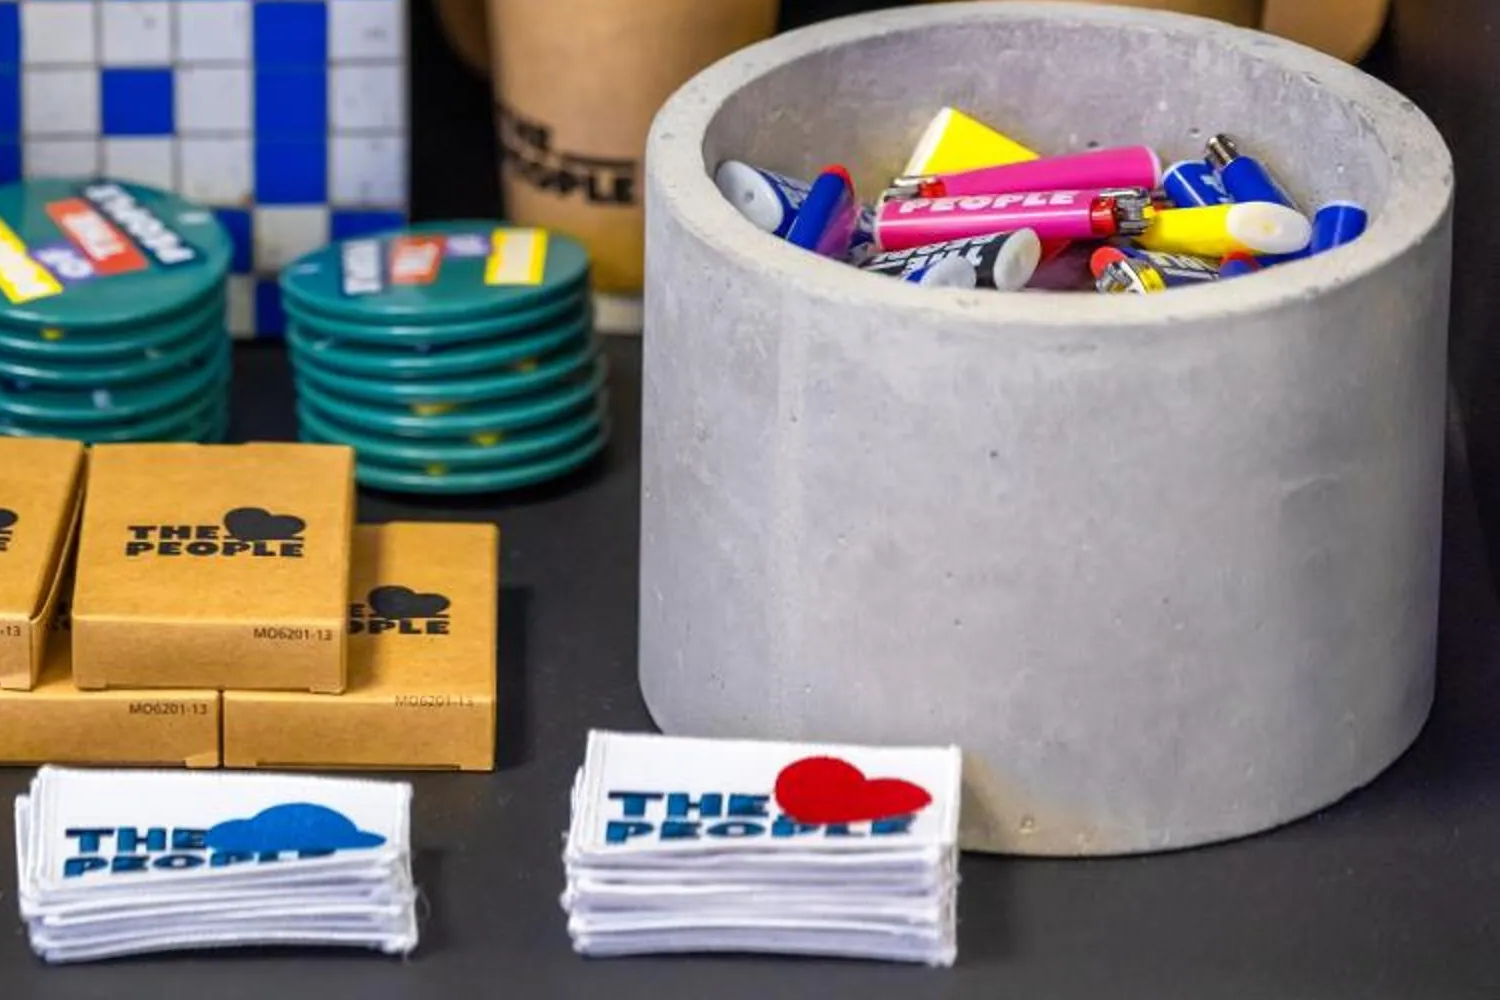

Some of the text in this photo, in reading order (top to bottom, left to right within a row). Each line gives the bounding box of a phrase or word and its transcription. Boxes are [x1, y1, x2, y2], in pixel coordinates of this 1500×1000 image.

[900, 189, 1077, 214] PEOPLE
[127, 525, 221, 540] THE
[125, 541, 305, 557] PEOPLE
[253, 626, 333, 642] MO6201-13
[129, 702, 208, 716] MO6201-13
[607, 791, 770, 818] THE
[64, 826, 209, 853] THE
